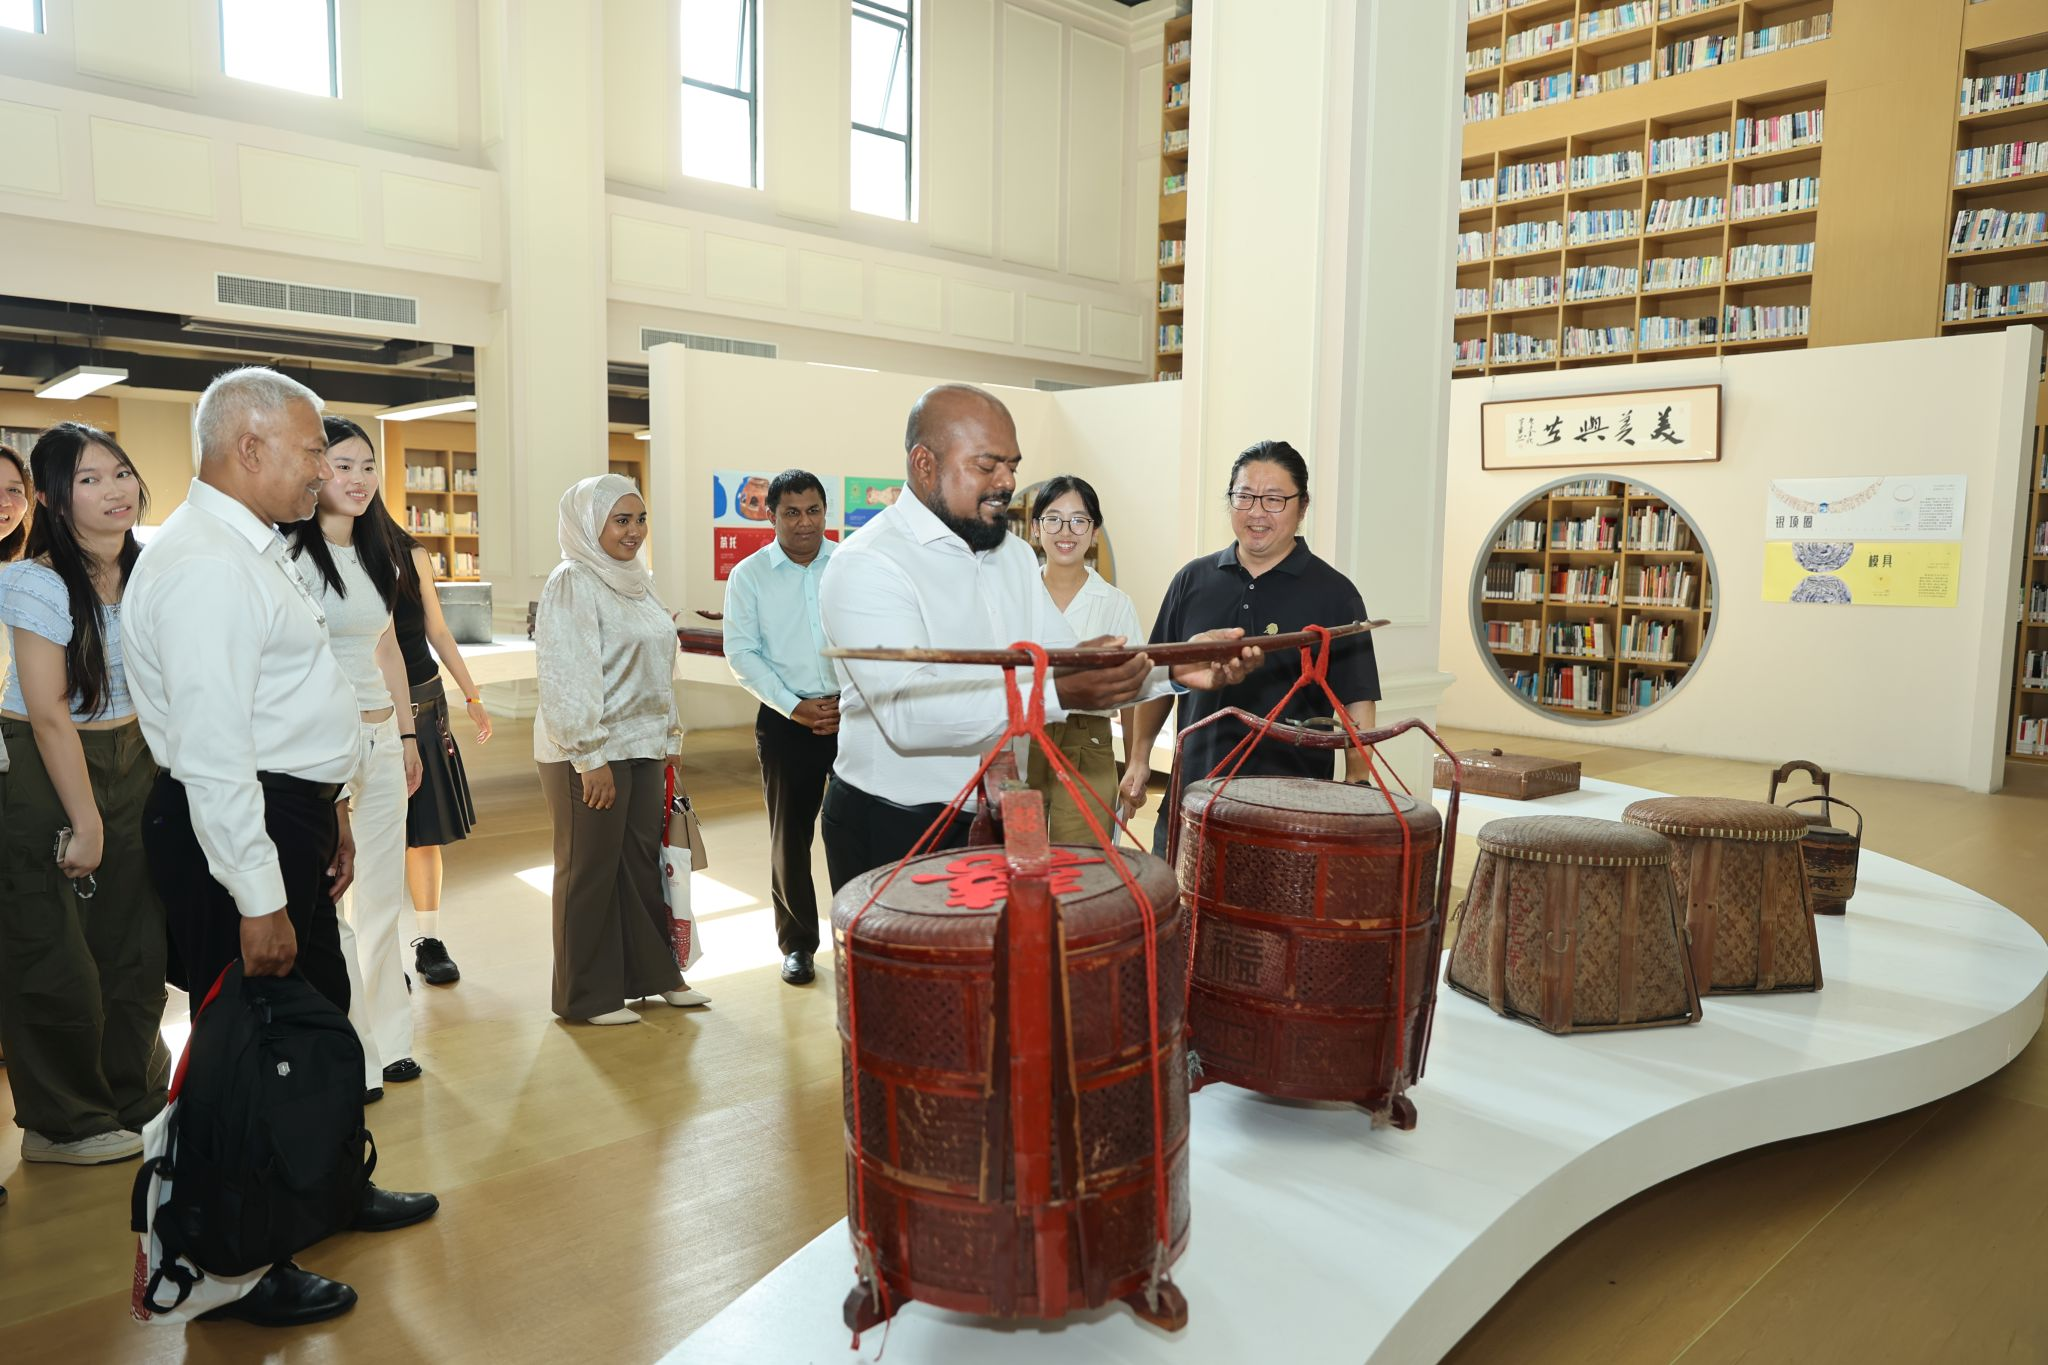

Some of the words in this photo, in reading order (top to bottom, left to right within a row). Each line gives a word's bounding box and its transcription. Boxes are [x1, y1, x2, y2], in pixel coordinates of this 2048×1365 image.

[1775, 515, 1813, 528] 银项圈
[1868, 554, 1893, 568] 模具
